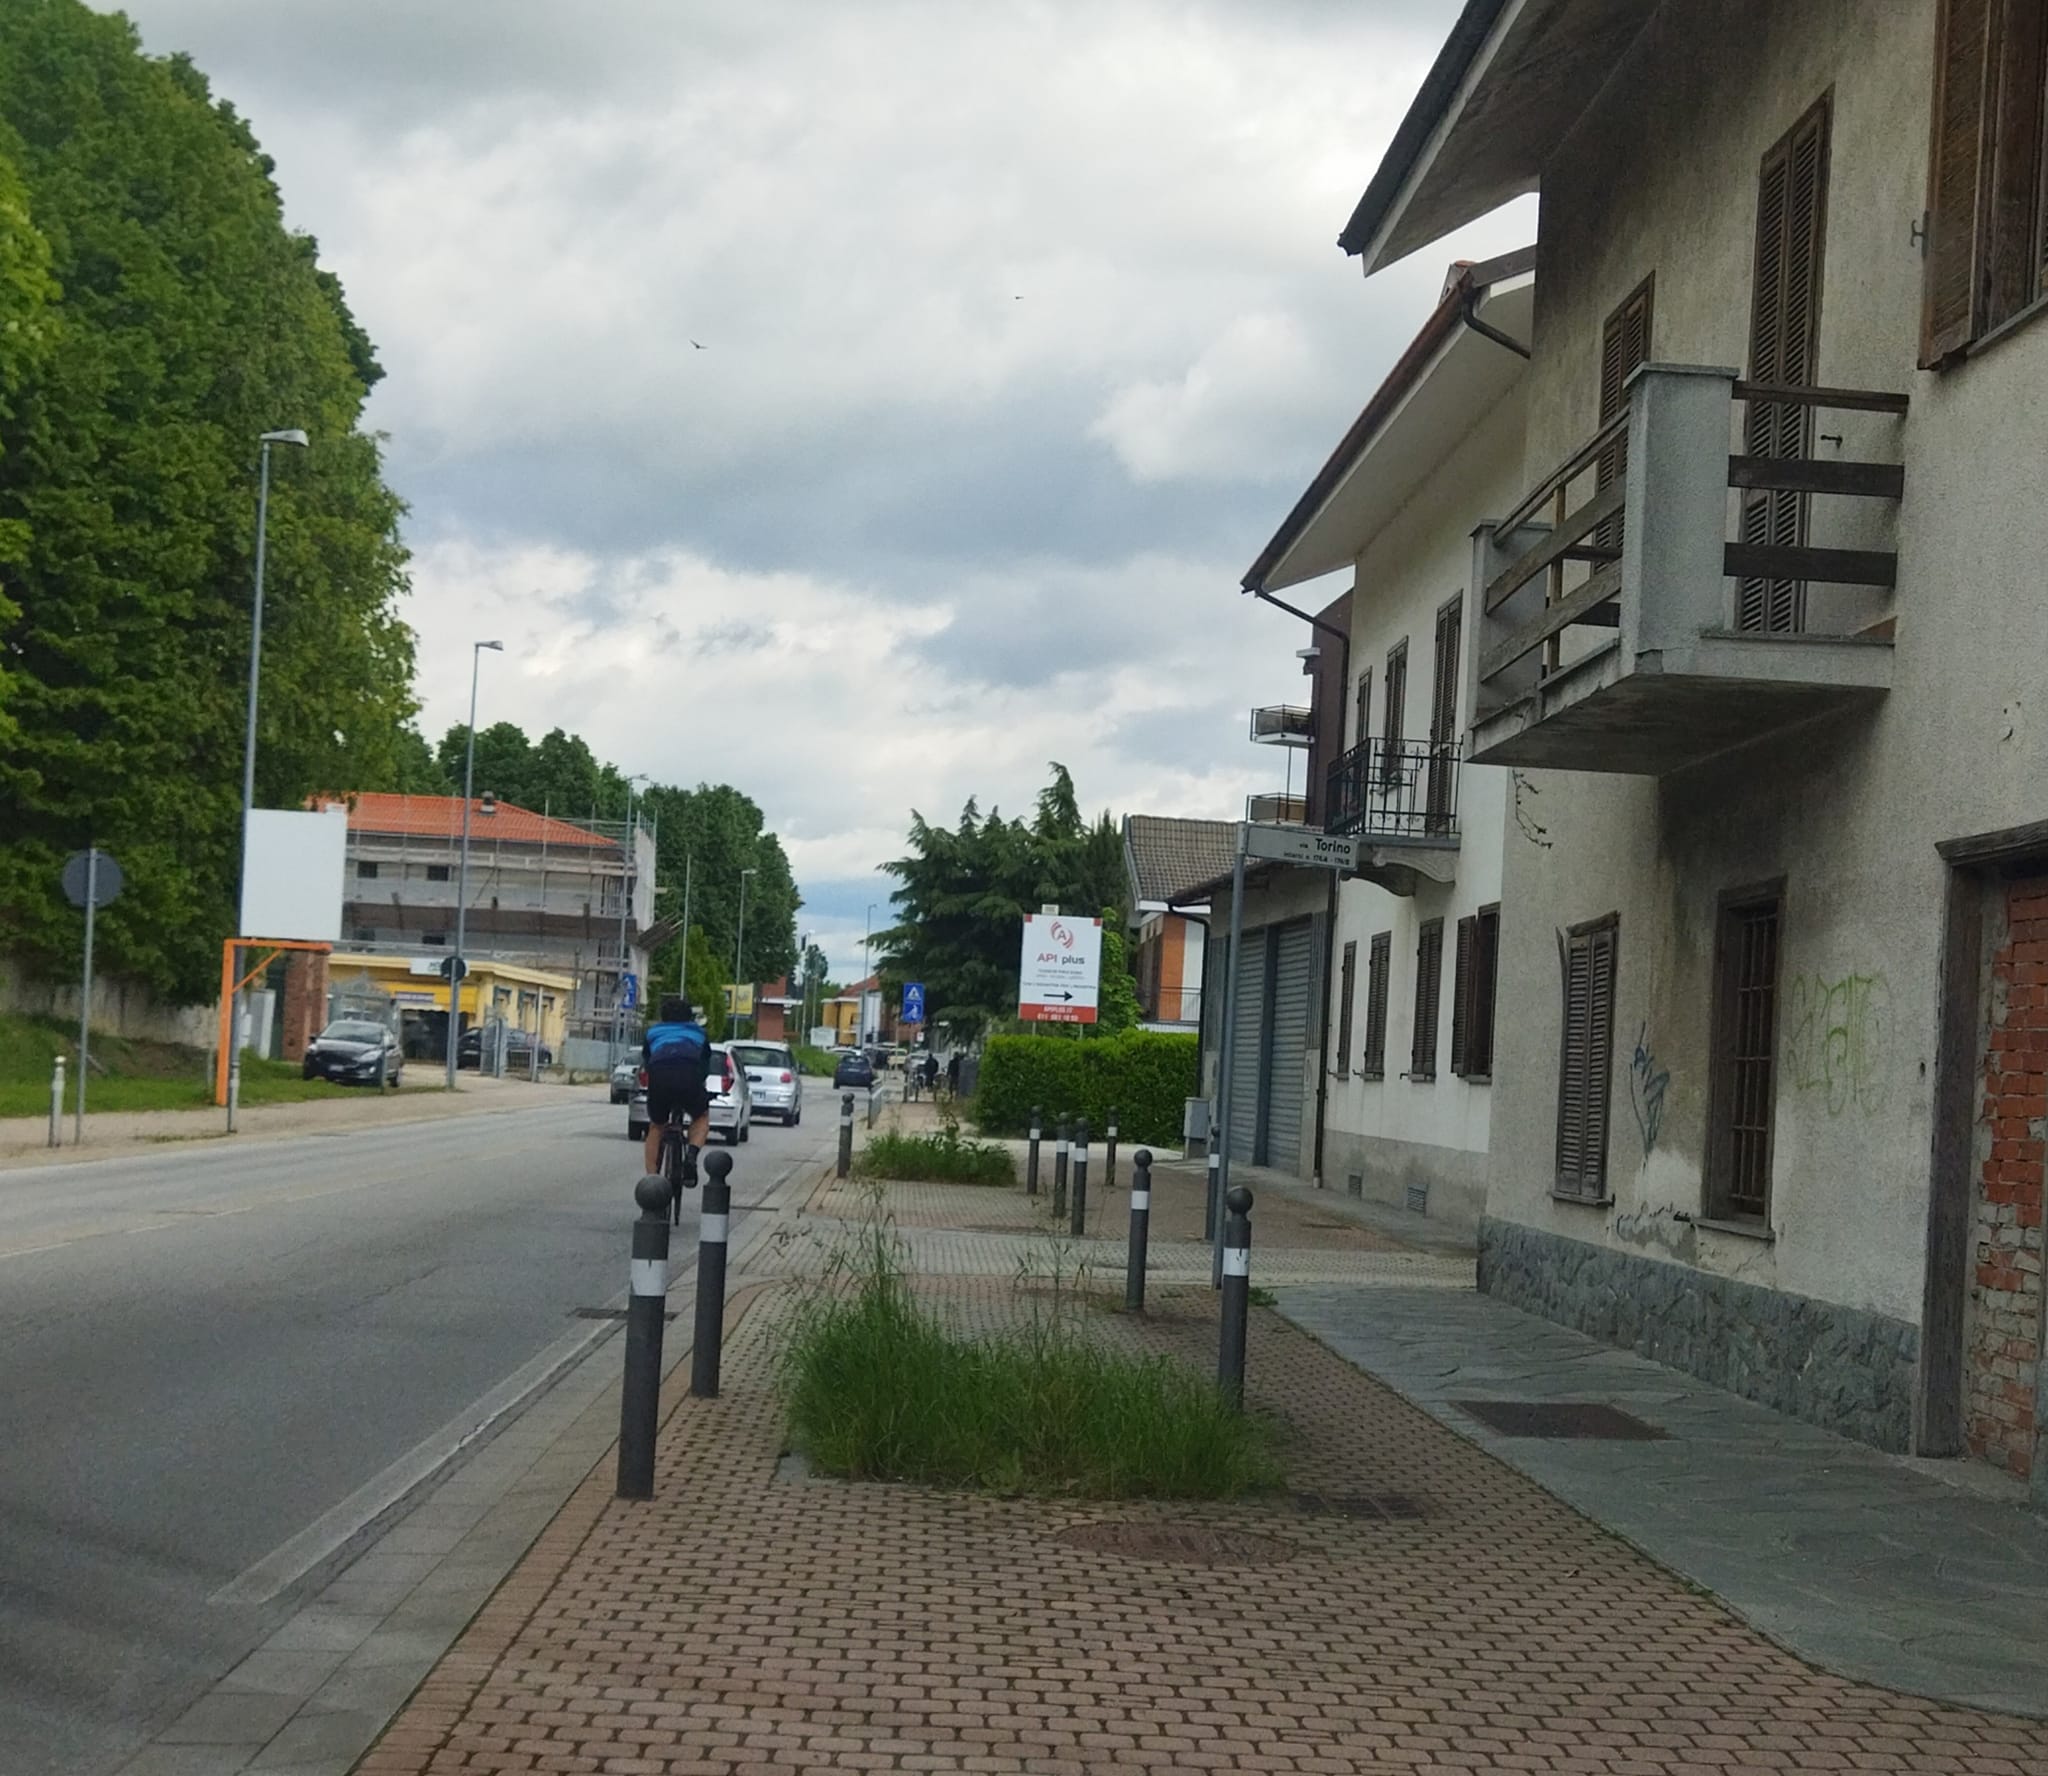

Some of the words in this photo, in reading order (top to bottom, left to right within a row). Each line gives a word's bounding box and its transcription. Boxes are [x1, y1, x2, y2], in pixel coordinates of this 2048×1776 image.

[1315, 838, 1351, 854] Torino
[1036, 952, 1057, 963] API
[1062, 955, 1085, 965] plus
